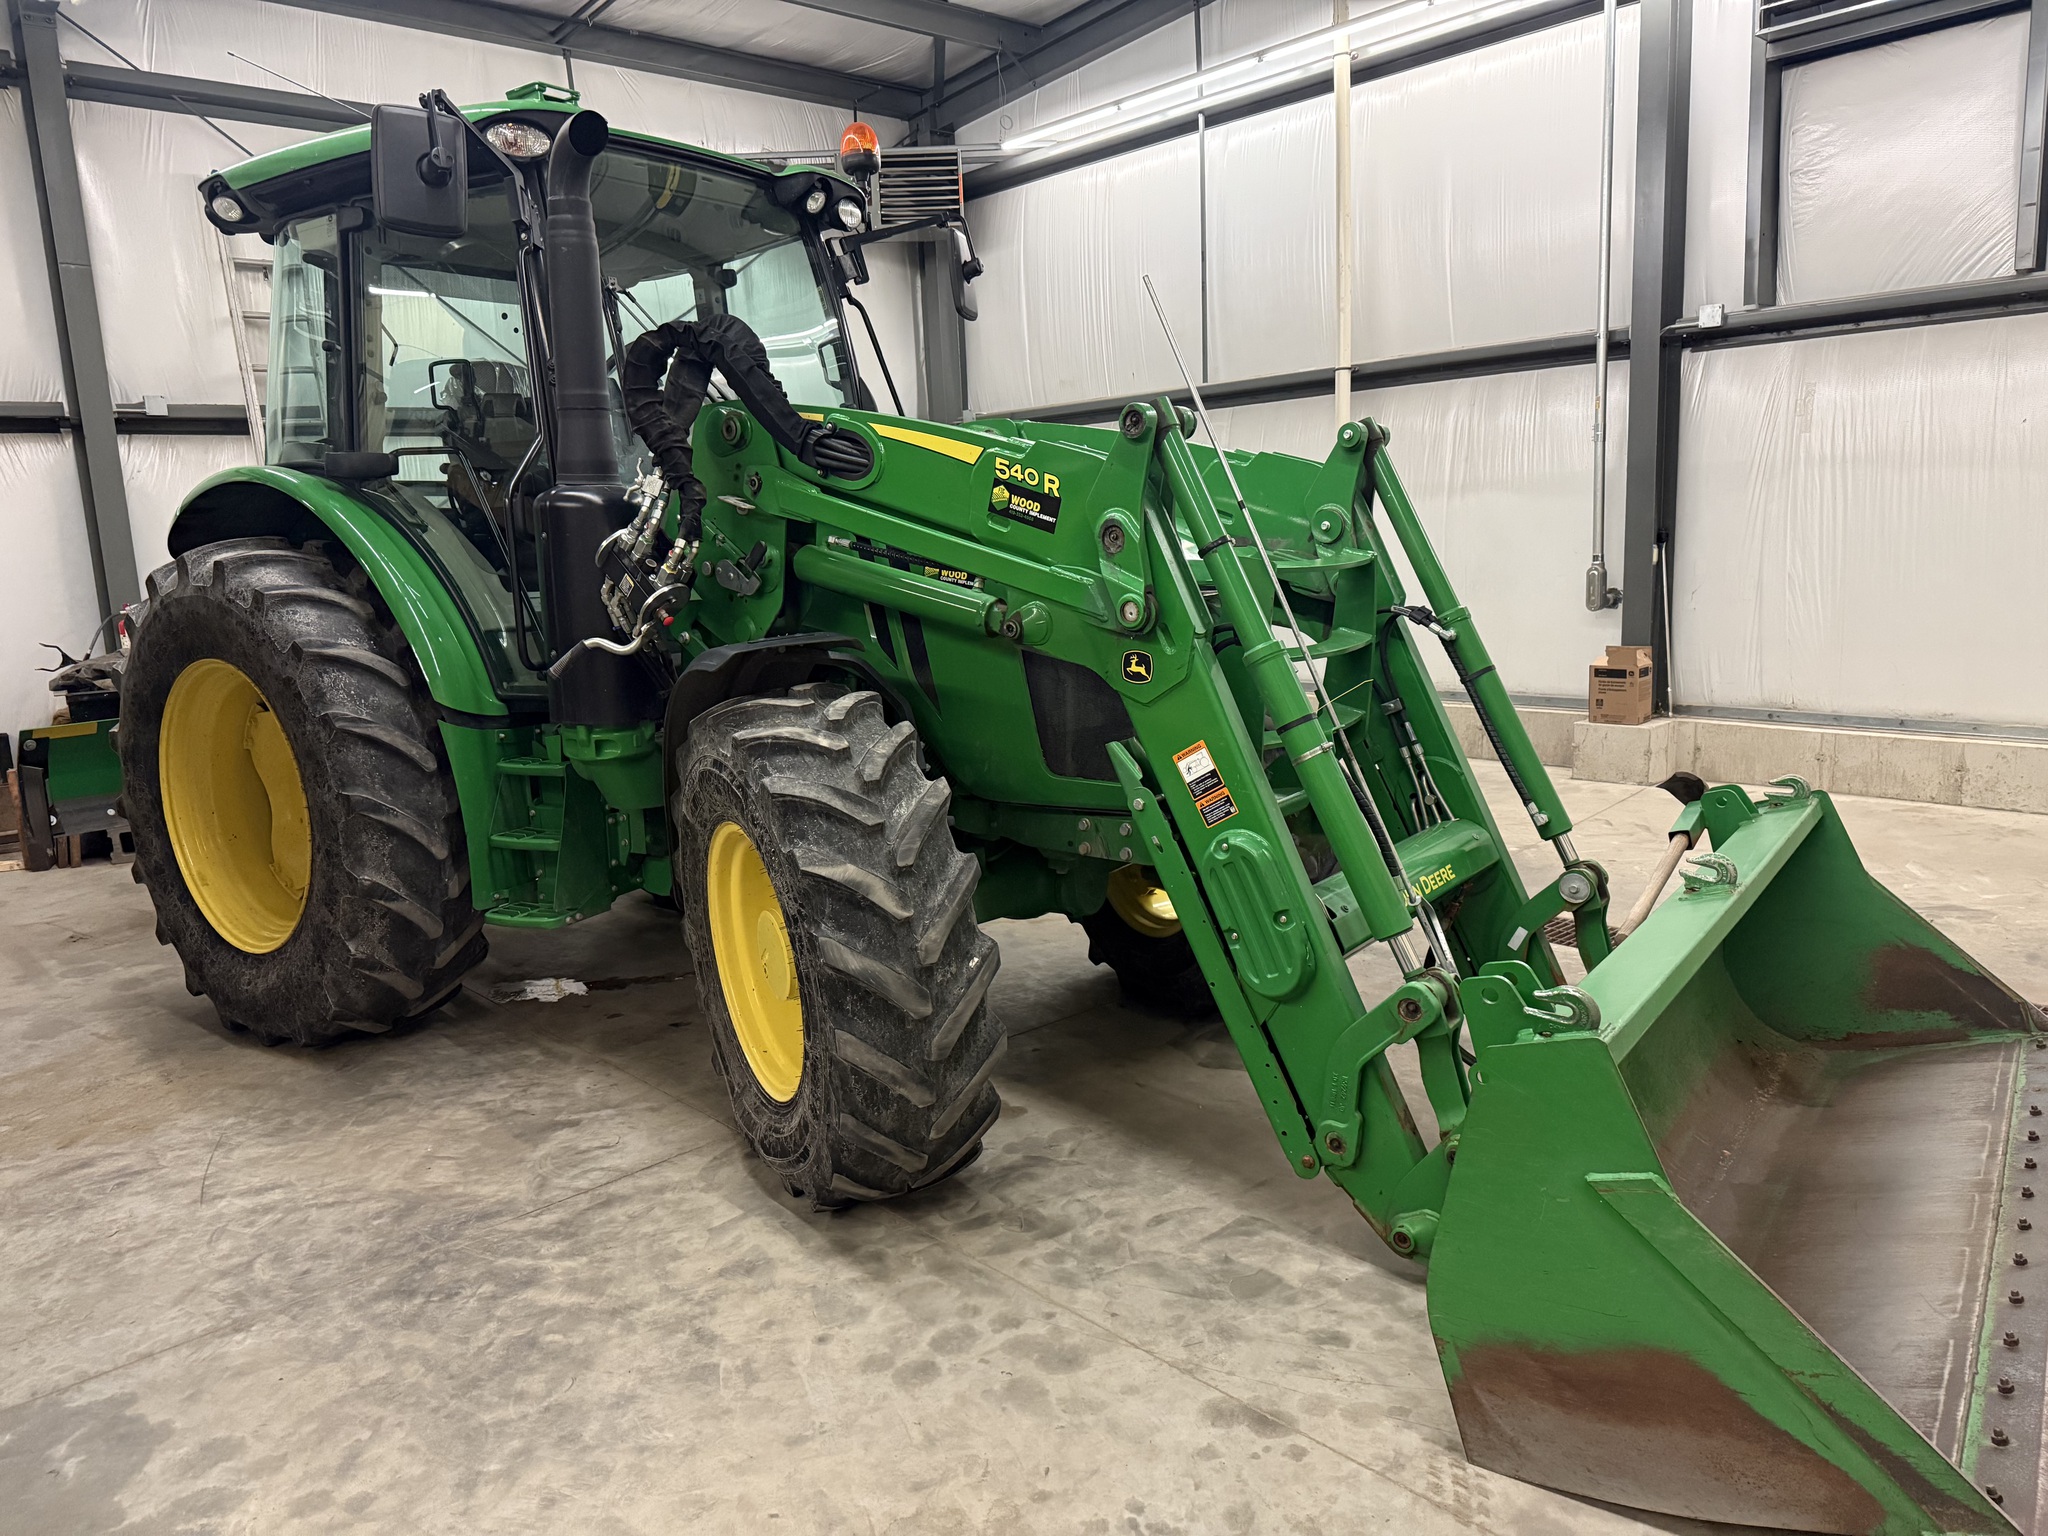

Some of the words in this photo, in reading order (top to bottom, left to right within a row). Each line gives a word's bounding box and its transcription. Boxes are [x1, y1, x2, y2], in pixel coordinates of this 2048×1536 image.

[995, 456, 1040, 486] 540
[1043, 472, 1061, 498] R
[1011, 494, 1041, 512] WOOD
[1009, 503, 1029, 514] COUNTY
[1029, 510, 1057, 523] IMPLEMENT
[1181, 744, 1202, 757] WARNING
[1205, 791, 1226, 804] WARNING
[1419, 864, 1456, 895] DEERE
